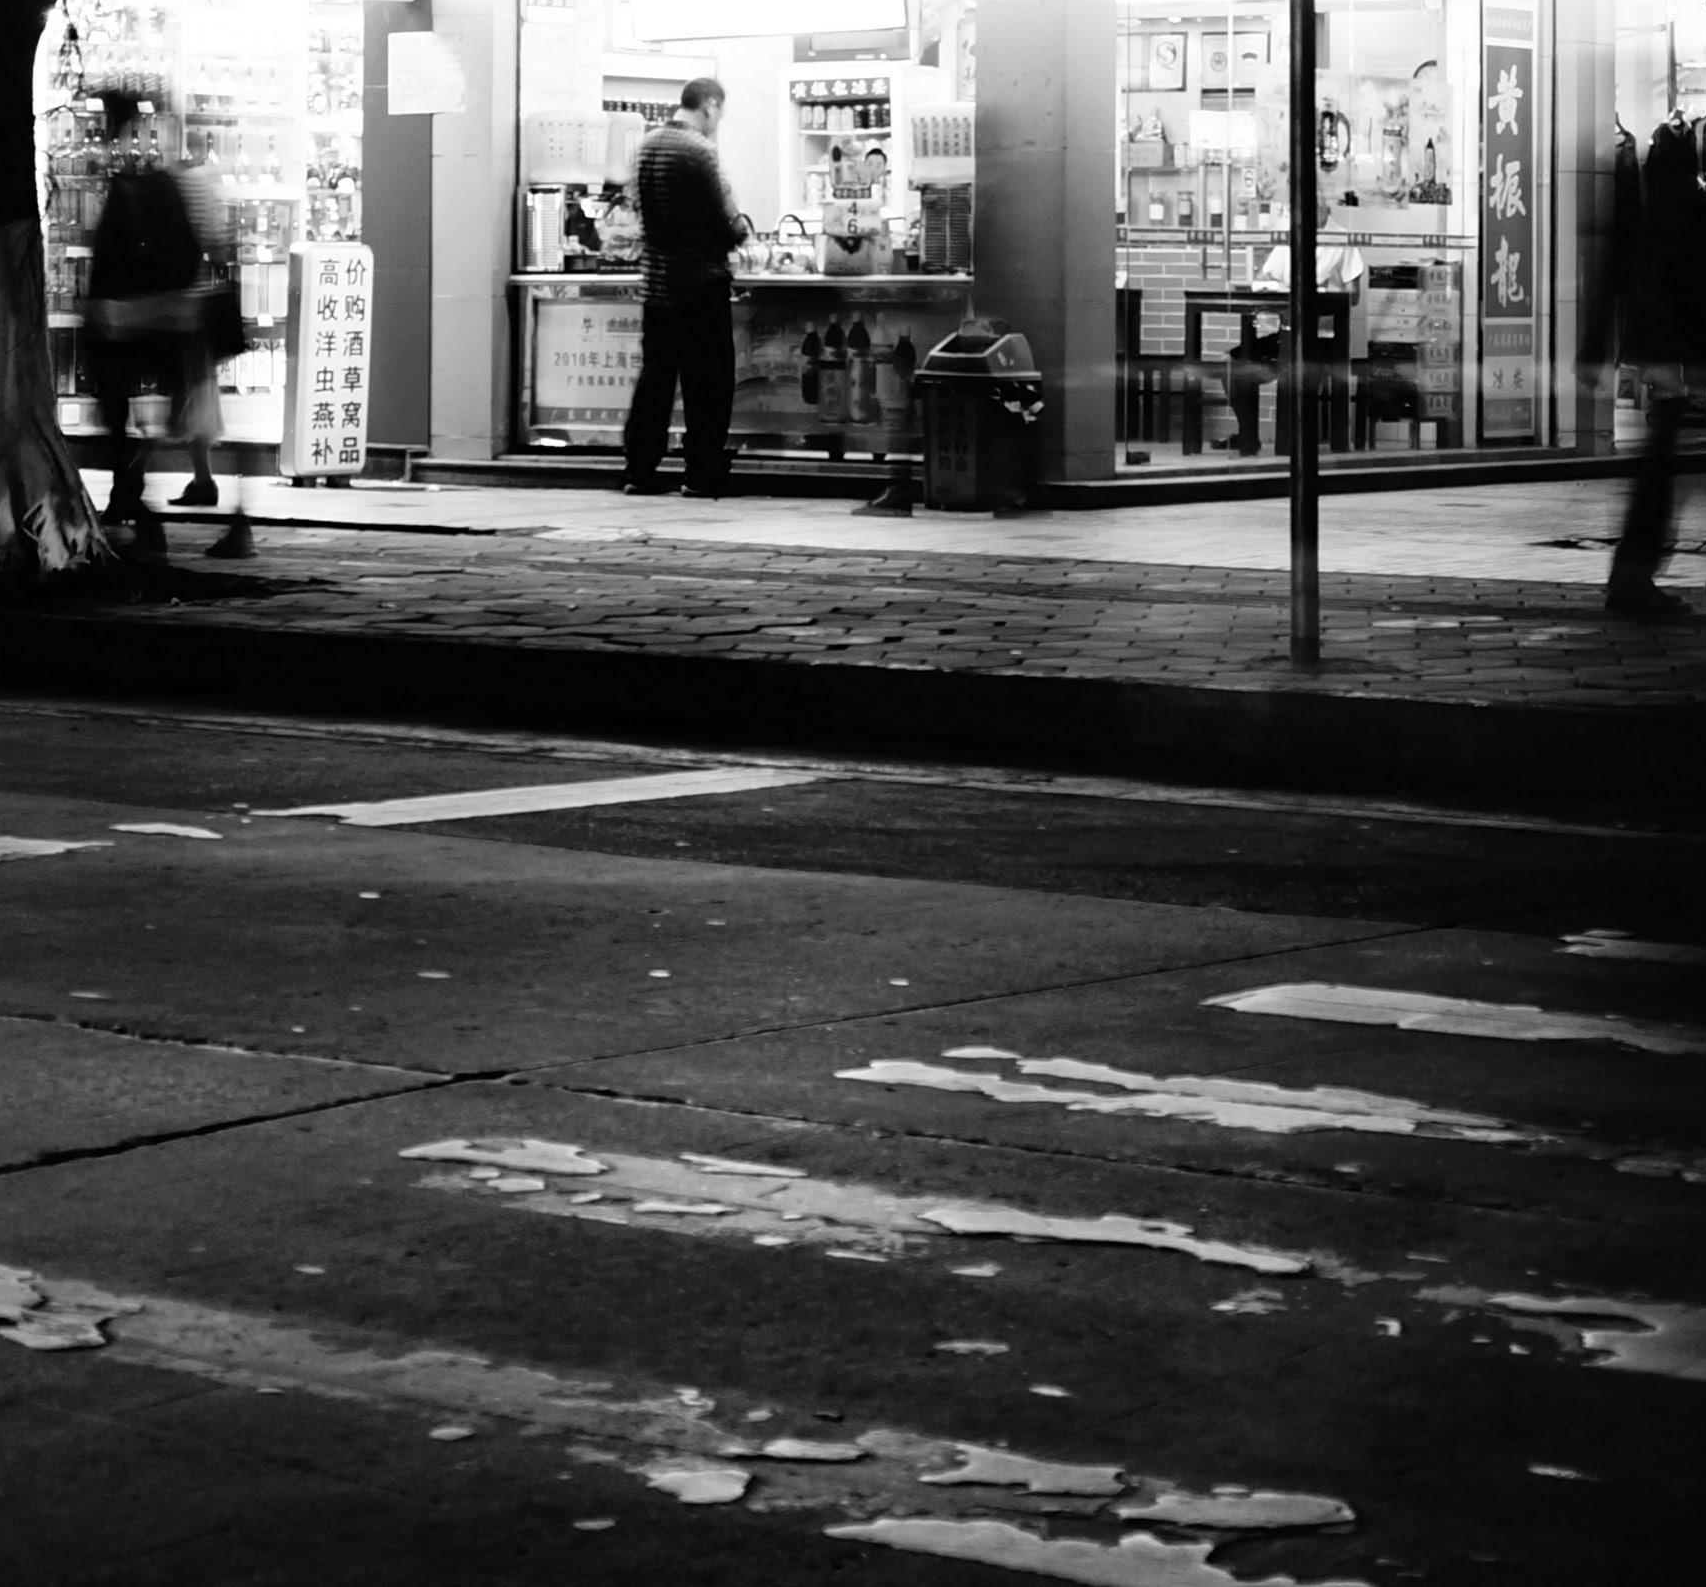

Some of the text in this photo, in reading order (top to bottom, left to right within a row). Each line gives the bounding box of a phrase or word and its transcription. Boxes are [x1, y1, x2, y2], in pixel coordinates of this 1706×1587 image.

[318, 258, 367, 287] 高价
[316, 294, 366, 322] 收购
[315, 330, 365, 358] 洋酒
[313, 365, 364, 393] 虫草
[311, 401, 363, 430] 燕窝
[310, 436, 361, 466] 补品
